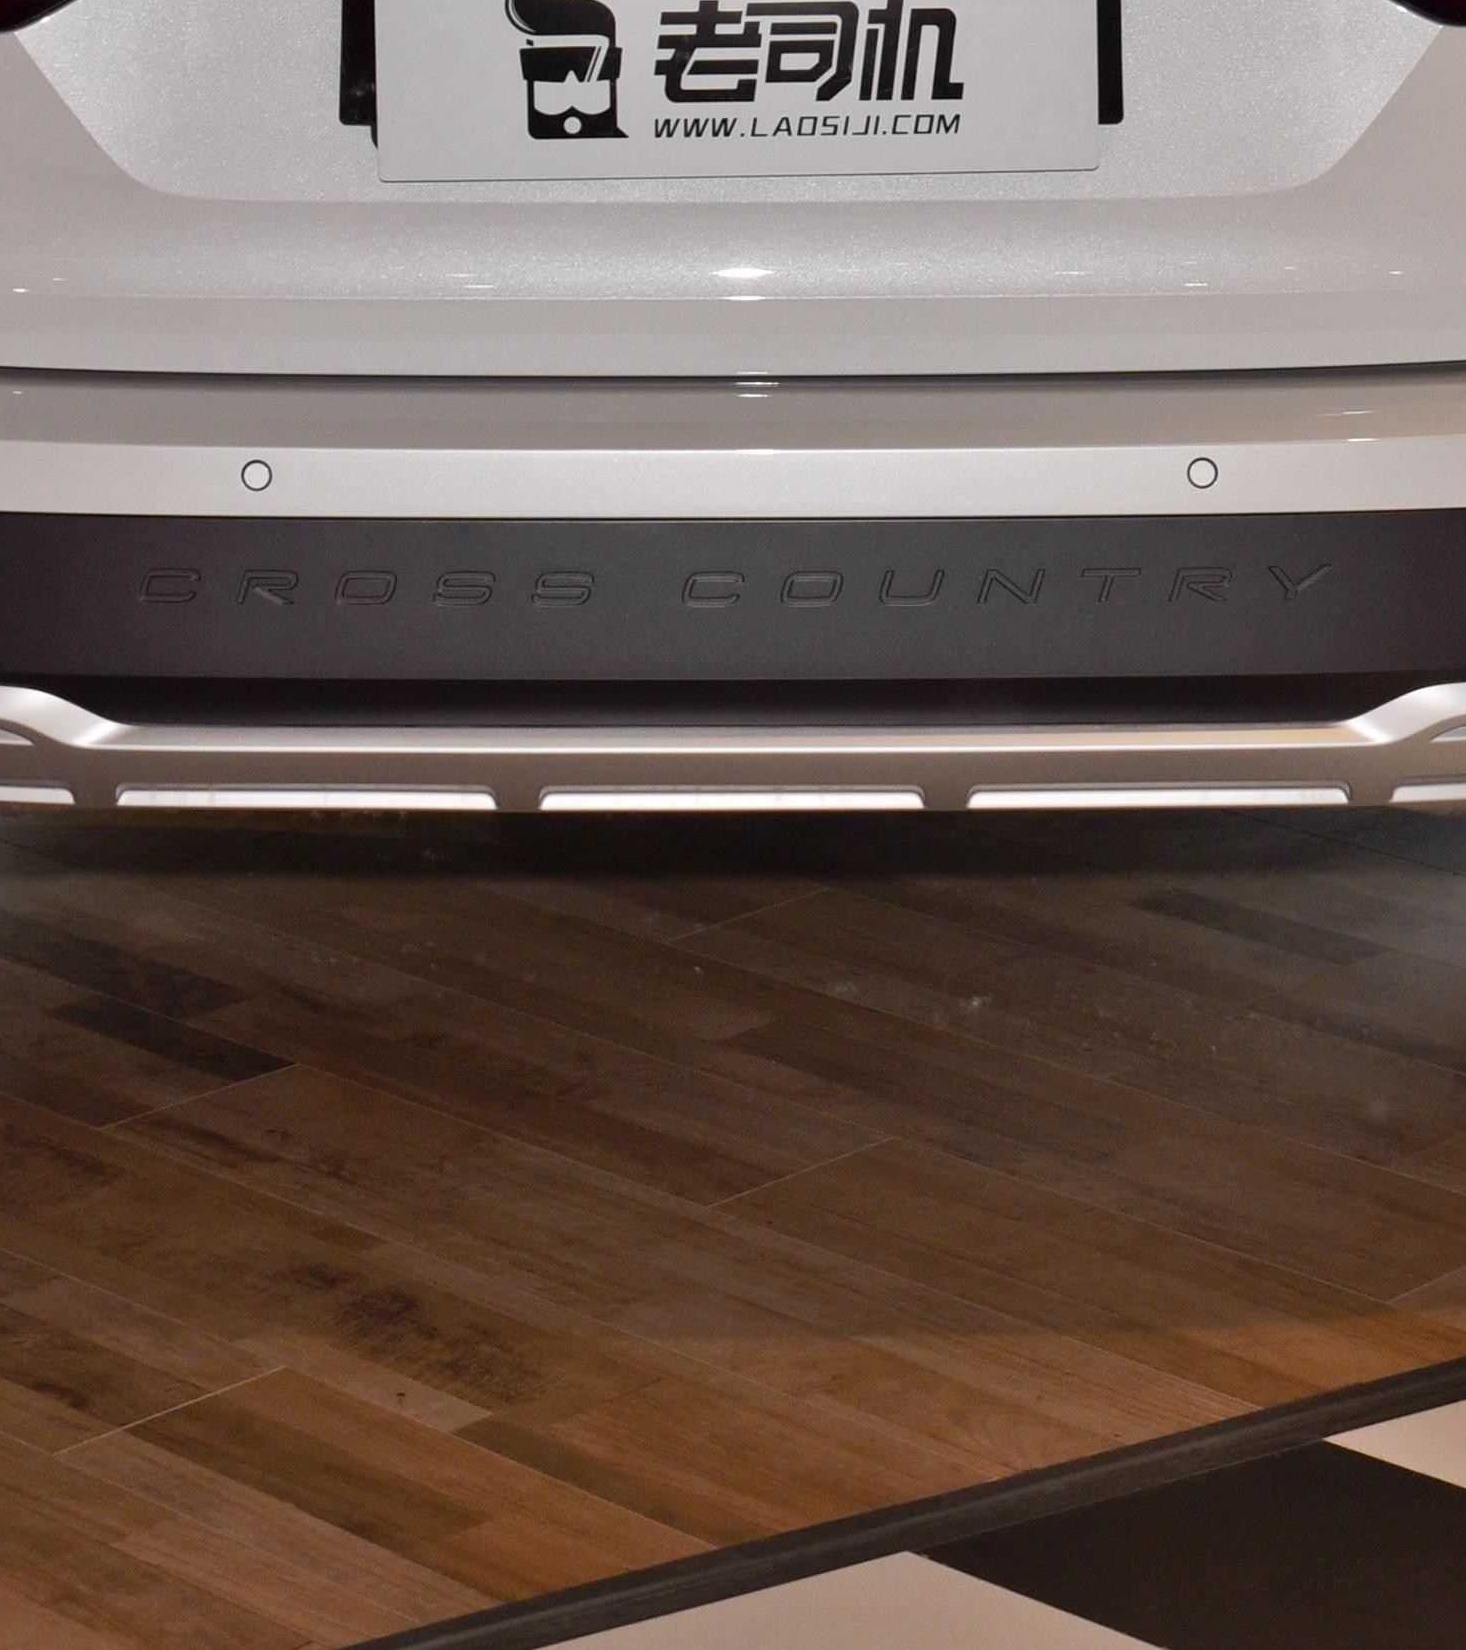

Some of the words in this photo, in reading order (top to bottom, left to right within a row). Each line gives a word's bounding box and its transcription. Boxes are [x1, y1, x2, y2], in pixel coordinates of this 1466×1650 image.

[652, 111, 962, 141] WWW.LAOSIJI.COM
[137, 565, 597, 608] CROSS
[681, 561, 1336, 606] COUNTRY
